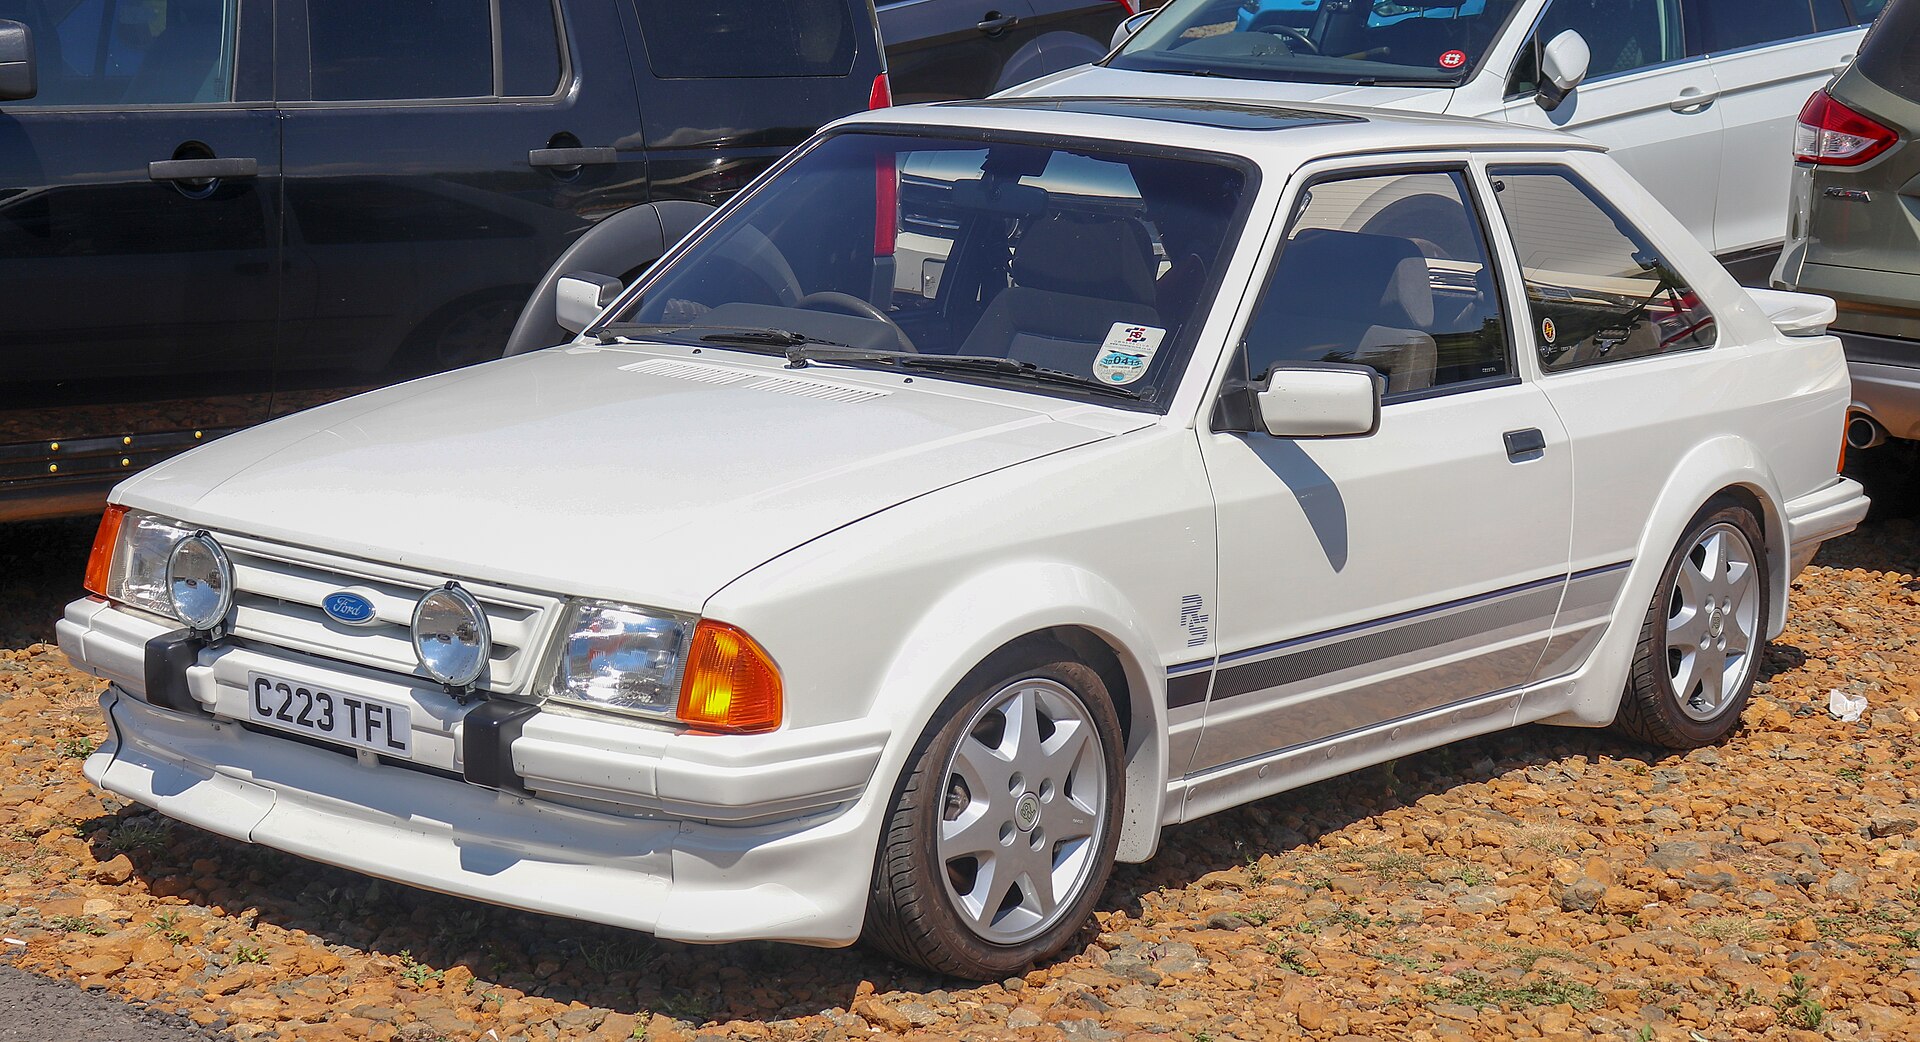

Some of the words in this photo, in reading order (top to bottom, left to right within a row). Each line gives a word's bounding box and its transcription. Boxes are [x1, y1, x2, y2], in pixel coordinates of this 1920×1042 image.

[1113, 355, 1129, 365] 04
[333, 597, 362, 616] Ford
[1180, 594, 1209, 648] RS
[254, 677, 335, 732] C223
[343, 697, 406, 751] TFL
